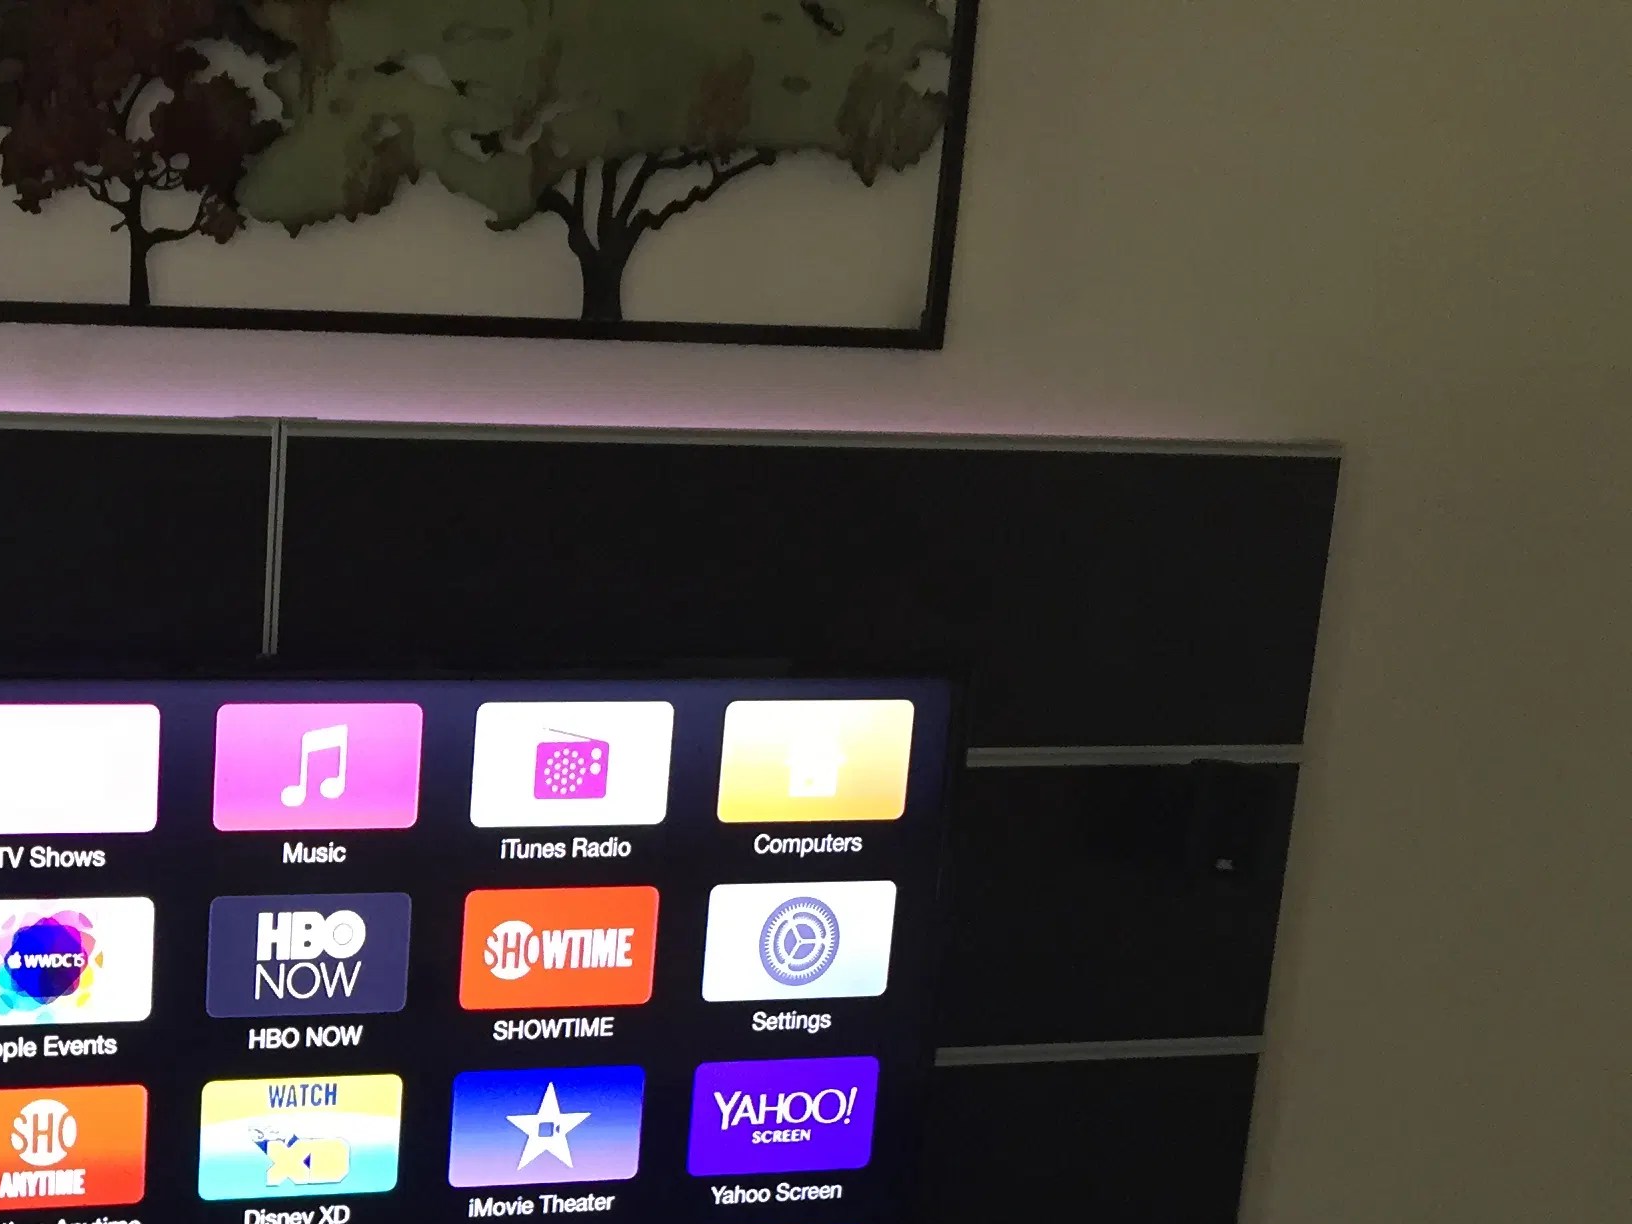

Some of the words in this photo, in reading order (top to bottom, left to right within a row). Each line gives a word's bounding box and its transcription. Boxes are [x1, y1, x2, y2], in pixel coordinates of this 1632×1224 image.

[29, 845, 106, 869] Shows
[282, 841, 347, 864] Music
[500, 838, 567, 860] iTunes
[571, 836, 632, 859] Radio
[753, 833, 863, 858] Computers
[257, 910, 366, 961] HBO
[24, 953, 86, 969] WWDC15
[484, 920, 635, 981] SHOWTIME
[254, 961, 362, 1001] NOW
[492, 1016, 615, 1041] SHOWTIME
[751, 1010, 832, 1034] Settings
[43, 1034, 118, 1057] Events
[248, 1026, 301, 1050] HBO
[305, 1024, 364, 1048] NOW
[269, 1083, 337, 1108] WATCH
[713, 1087, 858, 1130] YAHOO!
[752, 1129, 811, 1144] SCREEN
[468, 1196, 535, 1218] iMovie
[538, 1193, 616, 1215] Theater
[710, 1184, 772, 1205] Yahoo
[774, 1182, 843, 1202] Screen
